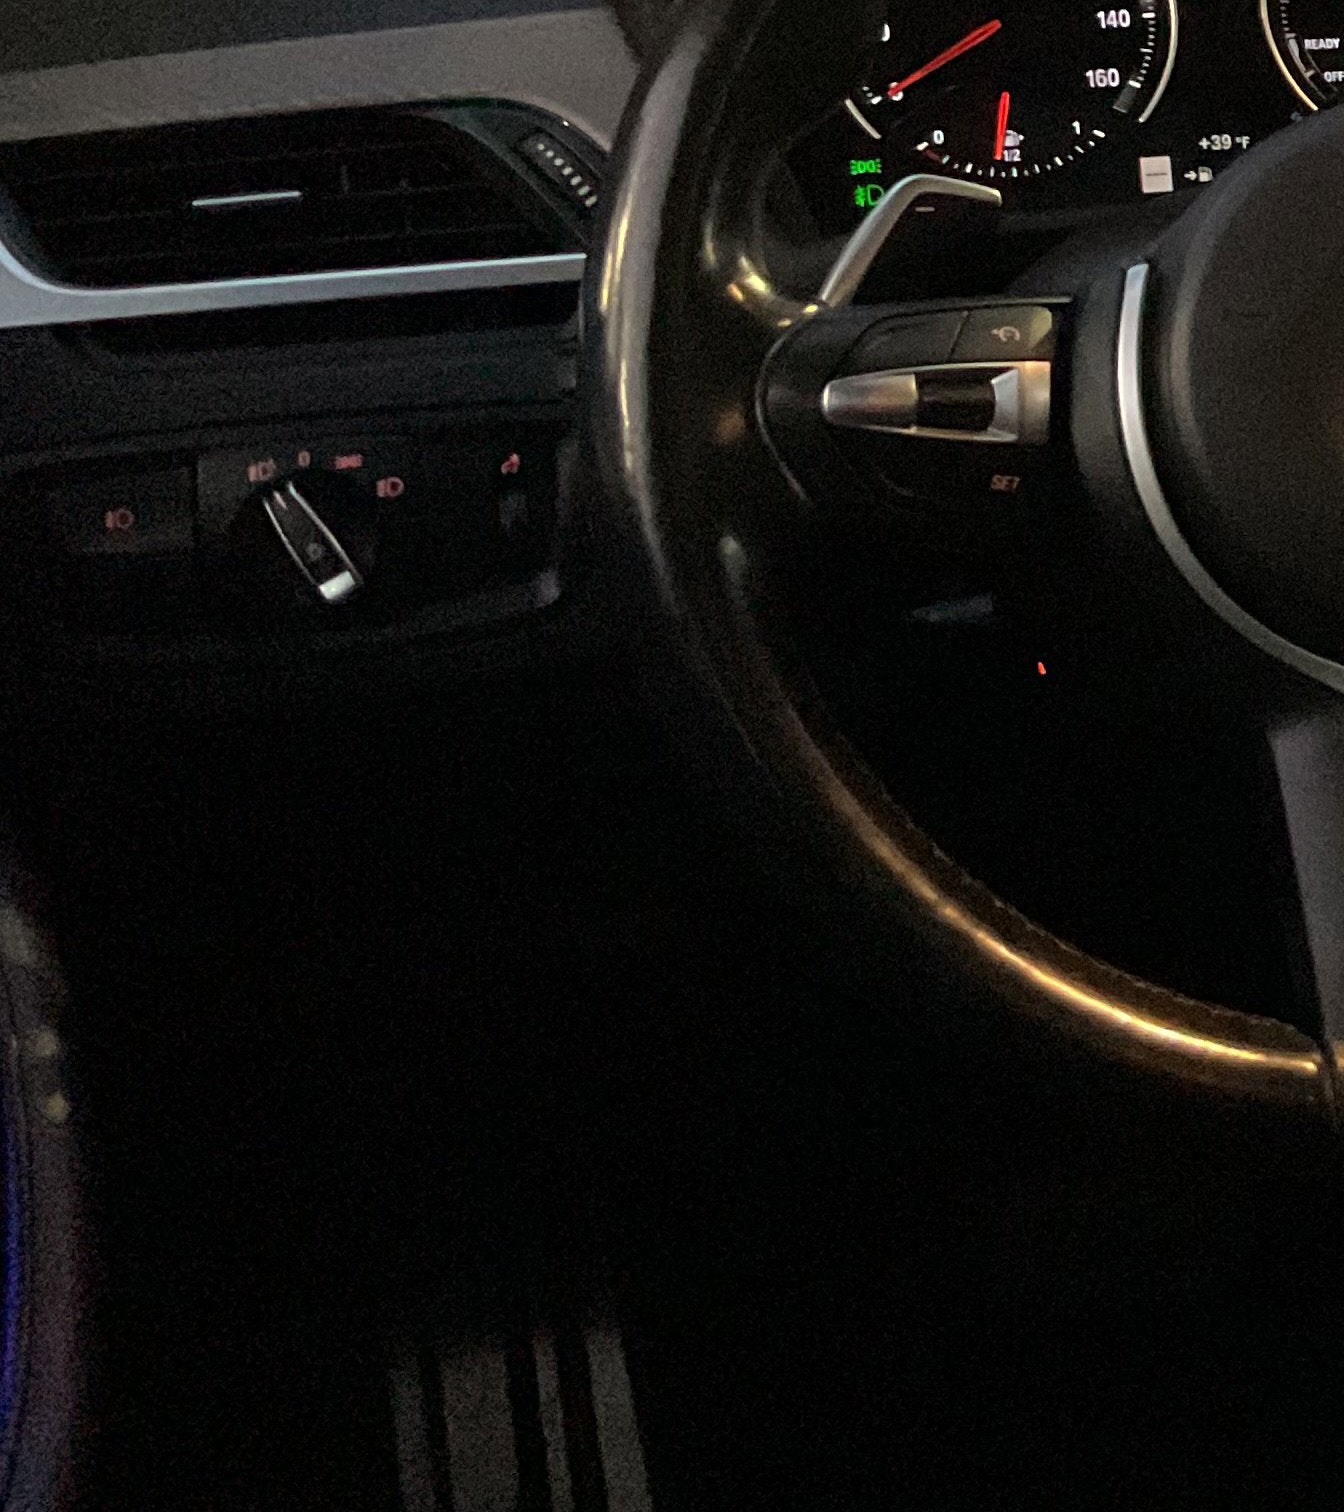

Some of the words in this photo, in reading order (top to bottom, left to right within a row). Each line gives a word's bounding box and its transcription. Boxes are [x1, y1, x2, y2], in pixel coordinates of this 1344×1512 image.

[1096, 9, 1131, 29] 140
[1304, 38, 1341, 50] READY
[1085, 67, 1120, 88] 160
[1324, 71, 1344, 83] OFF
[1072, 120, 1082, 136] 1
[932, 129, 945, 145] 0
[1198, 133, 1233, 151] +39
